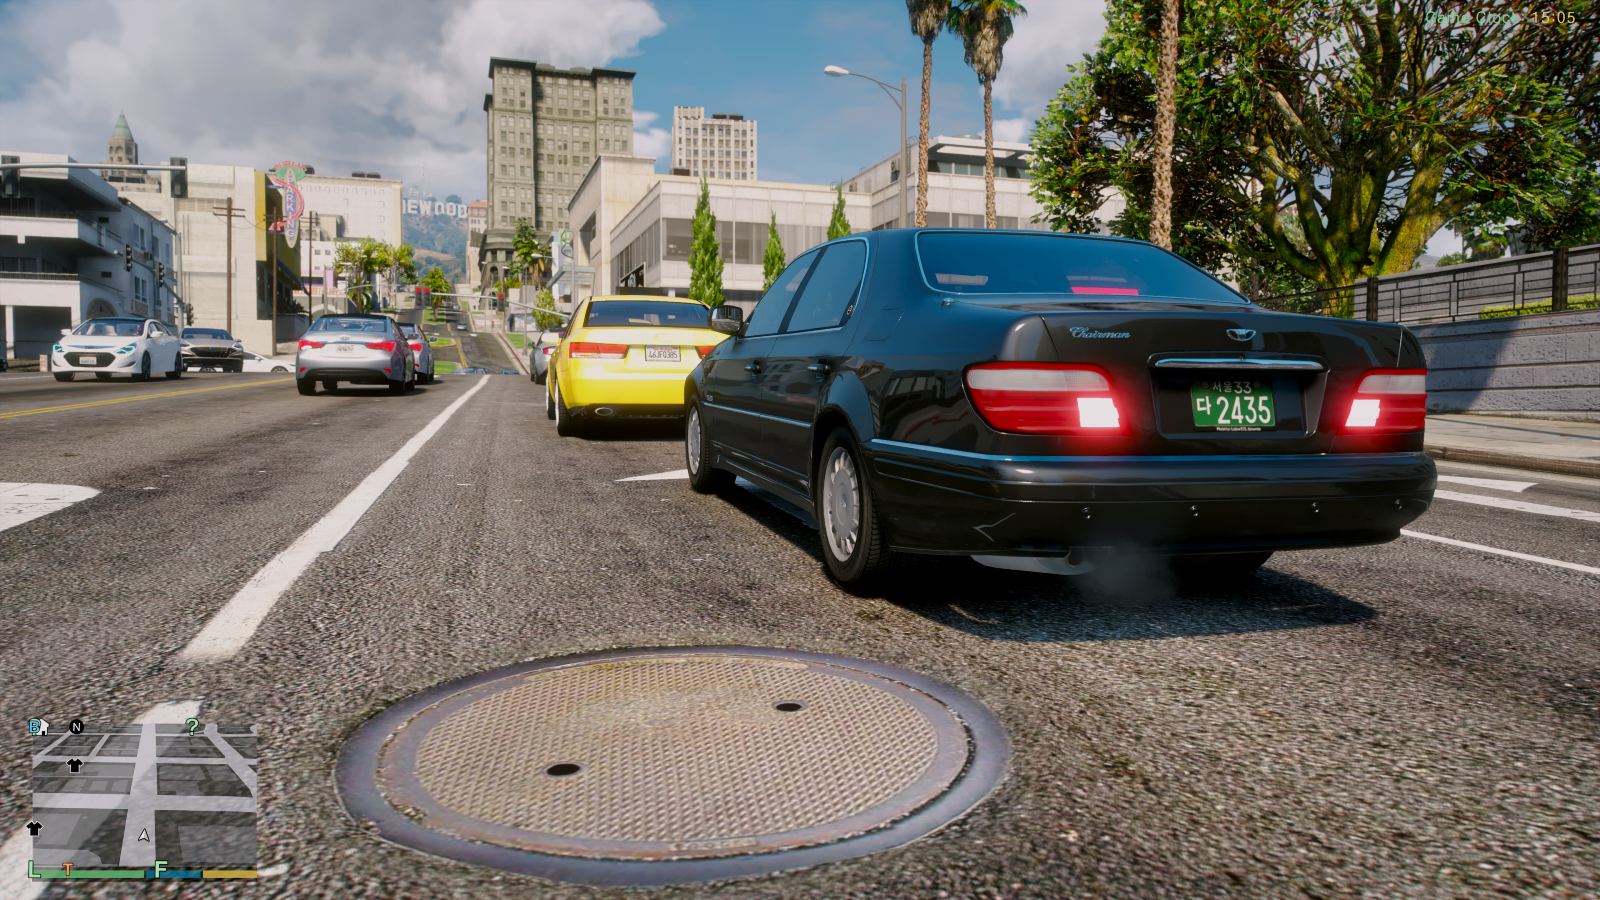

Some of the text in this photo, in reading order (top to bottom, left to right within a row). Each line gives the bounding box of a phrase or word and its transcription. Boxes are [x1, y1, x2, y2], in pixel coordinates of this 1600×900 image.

[273, 160, 307, 173] PUBLIC
[285, 177, 295, 237] PARKING
[403, 200, 467, 218] EWOOD
[1069, 326, 1131, 339] Chairman
[1216, 395, 1271, 424] 2435
